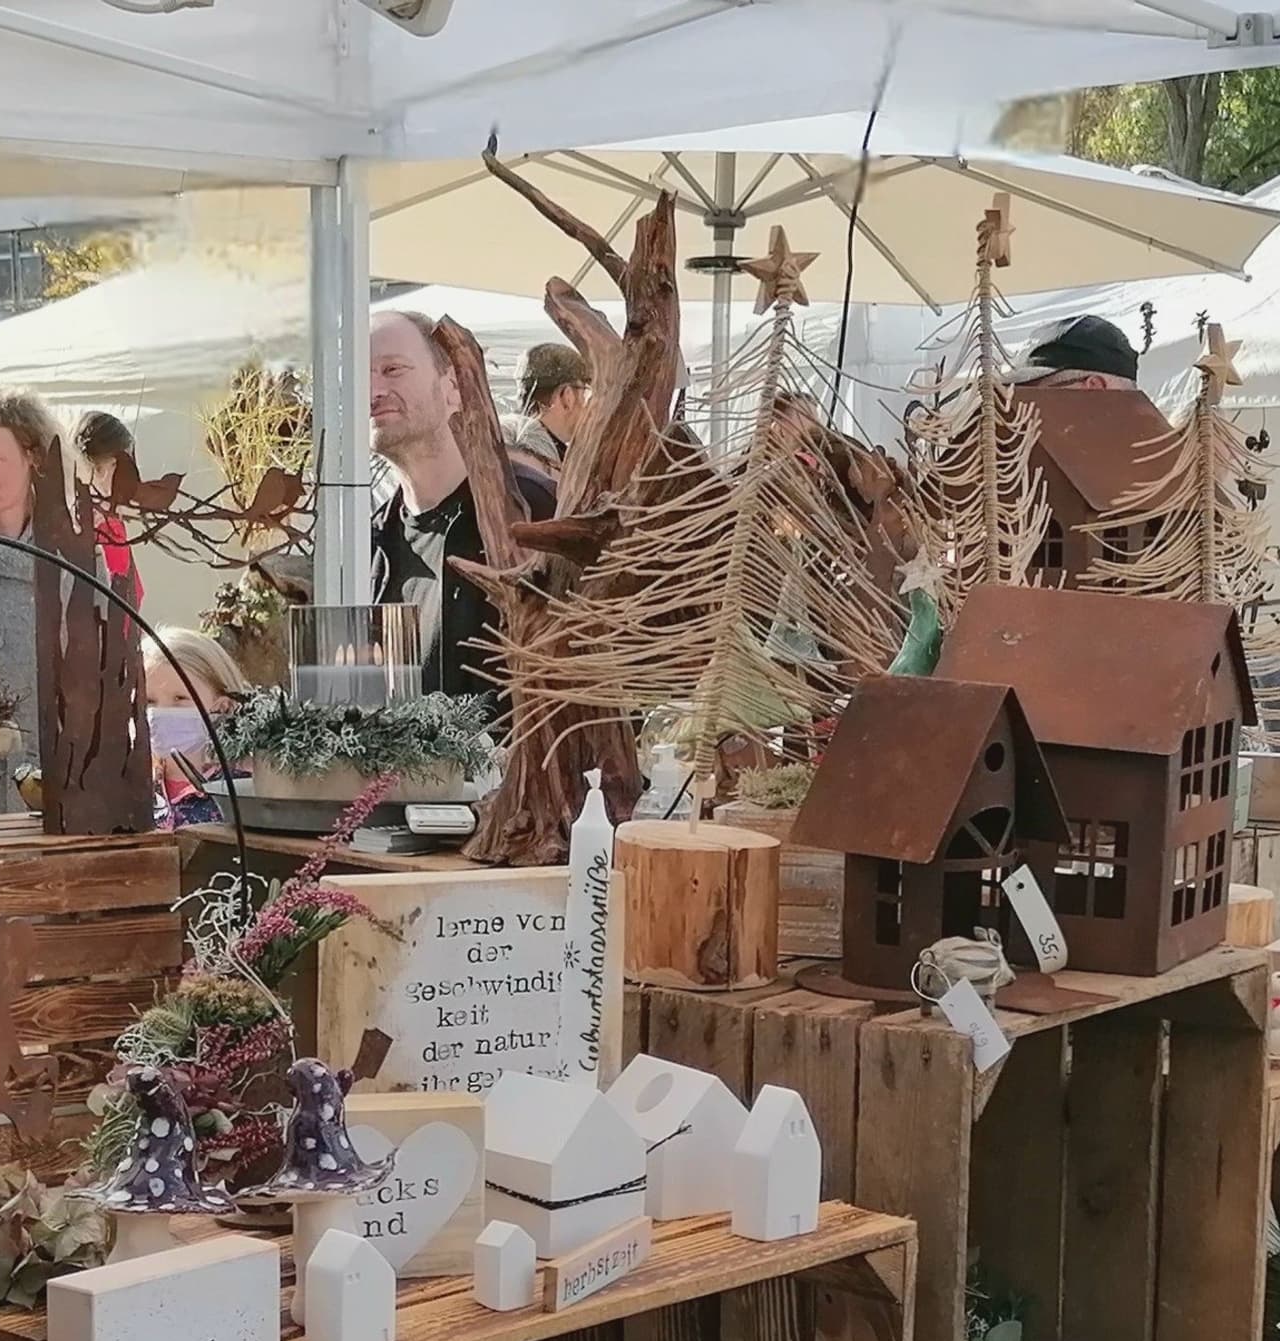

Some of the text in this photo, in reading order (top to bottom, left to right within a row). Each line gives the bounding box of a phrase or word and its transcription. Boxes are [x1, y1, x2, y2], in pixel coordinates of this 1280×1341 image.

[436, 916, 505, 938] lerne
[467, 942, 513, 964] der
[436, 1004, 489, 1028] keit
[422, 1041, 464, 1063] der
[562, 1240, 639, 1302] herbstzeit
